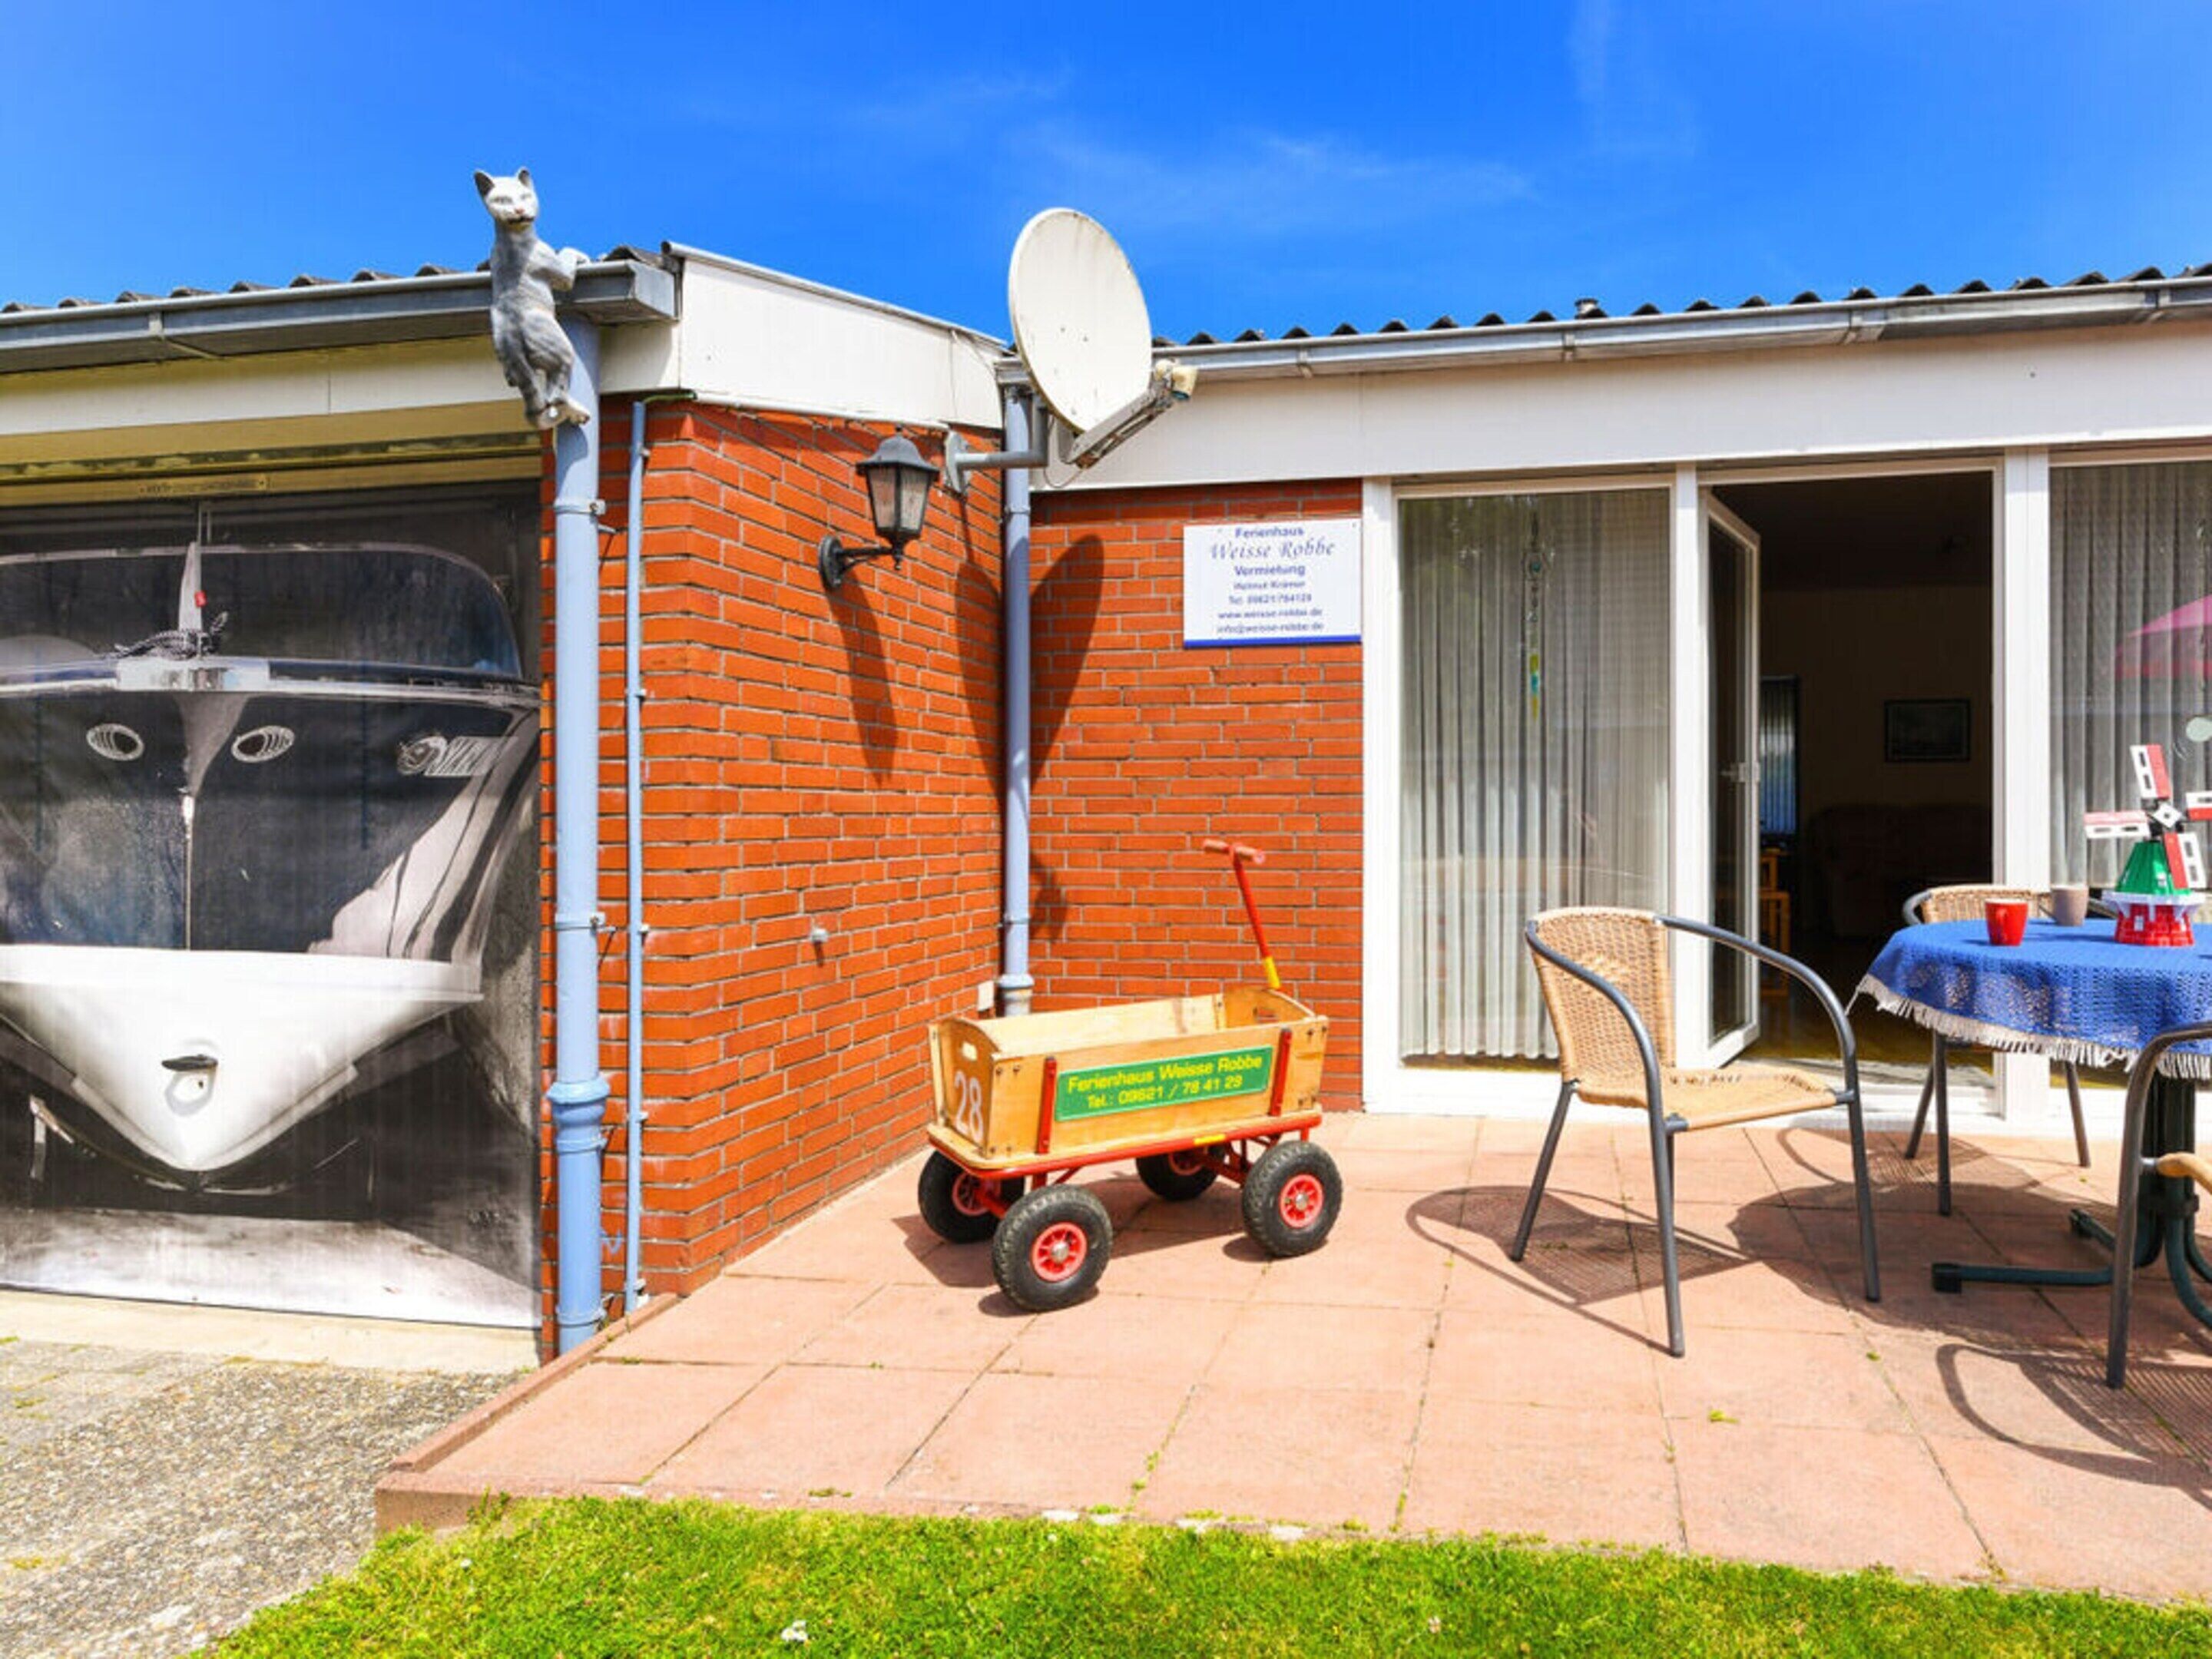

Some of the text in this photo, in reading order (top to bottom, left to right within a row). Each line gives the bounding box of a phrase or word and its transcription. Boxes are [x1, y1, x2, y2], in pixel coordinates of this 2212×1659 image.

[1235, 527, 1304, 538] Ferienhaus
[1211, 538, 1335, 559] Weisse Robbe
[1234, 565, 1306, 577] Vermietung
[1068, 1055, 1263, 1094] Ferienhaus Weisse Robbe
[1203, 1078, 1220, 1091] 41
[1224, 1075, 1243, 1089] 29
[955, 1070, 984, 1142] 28
